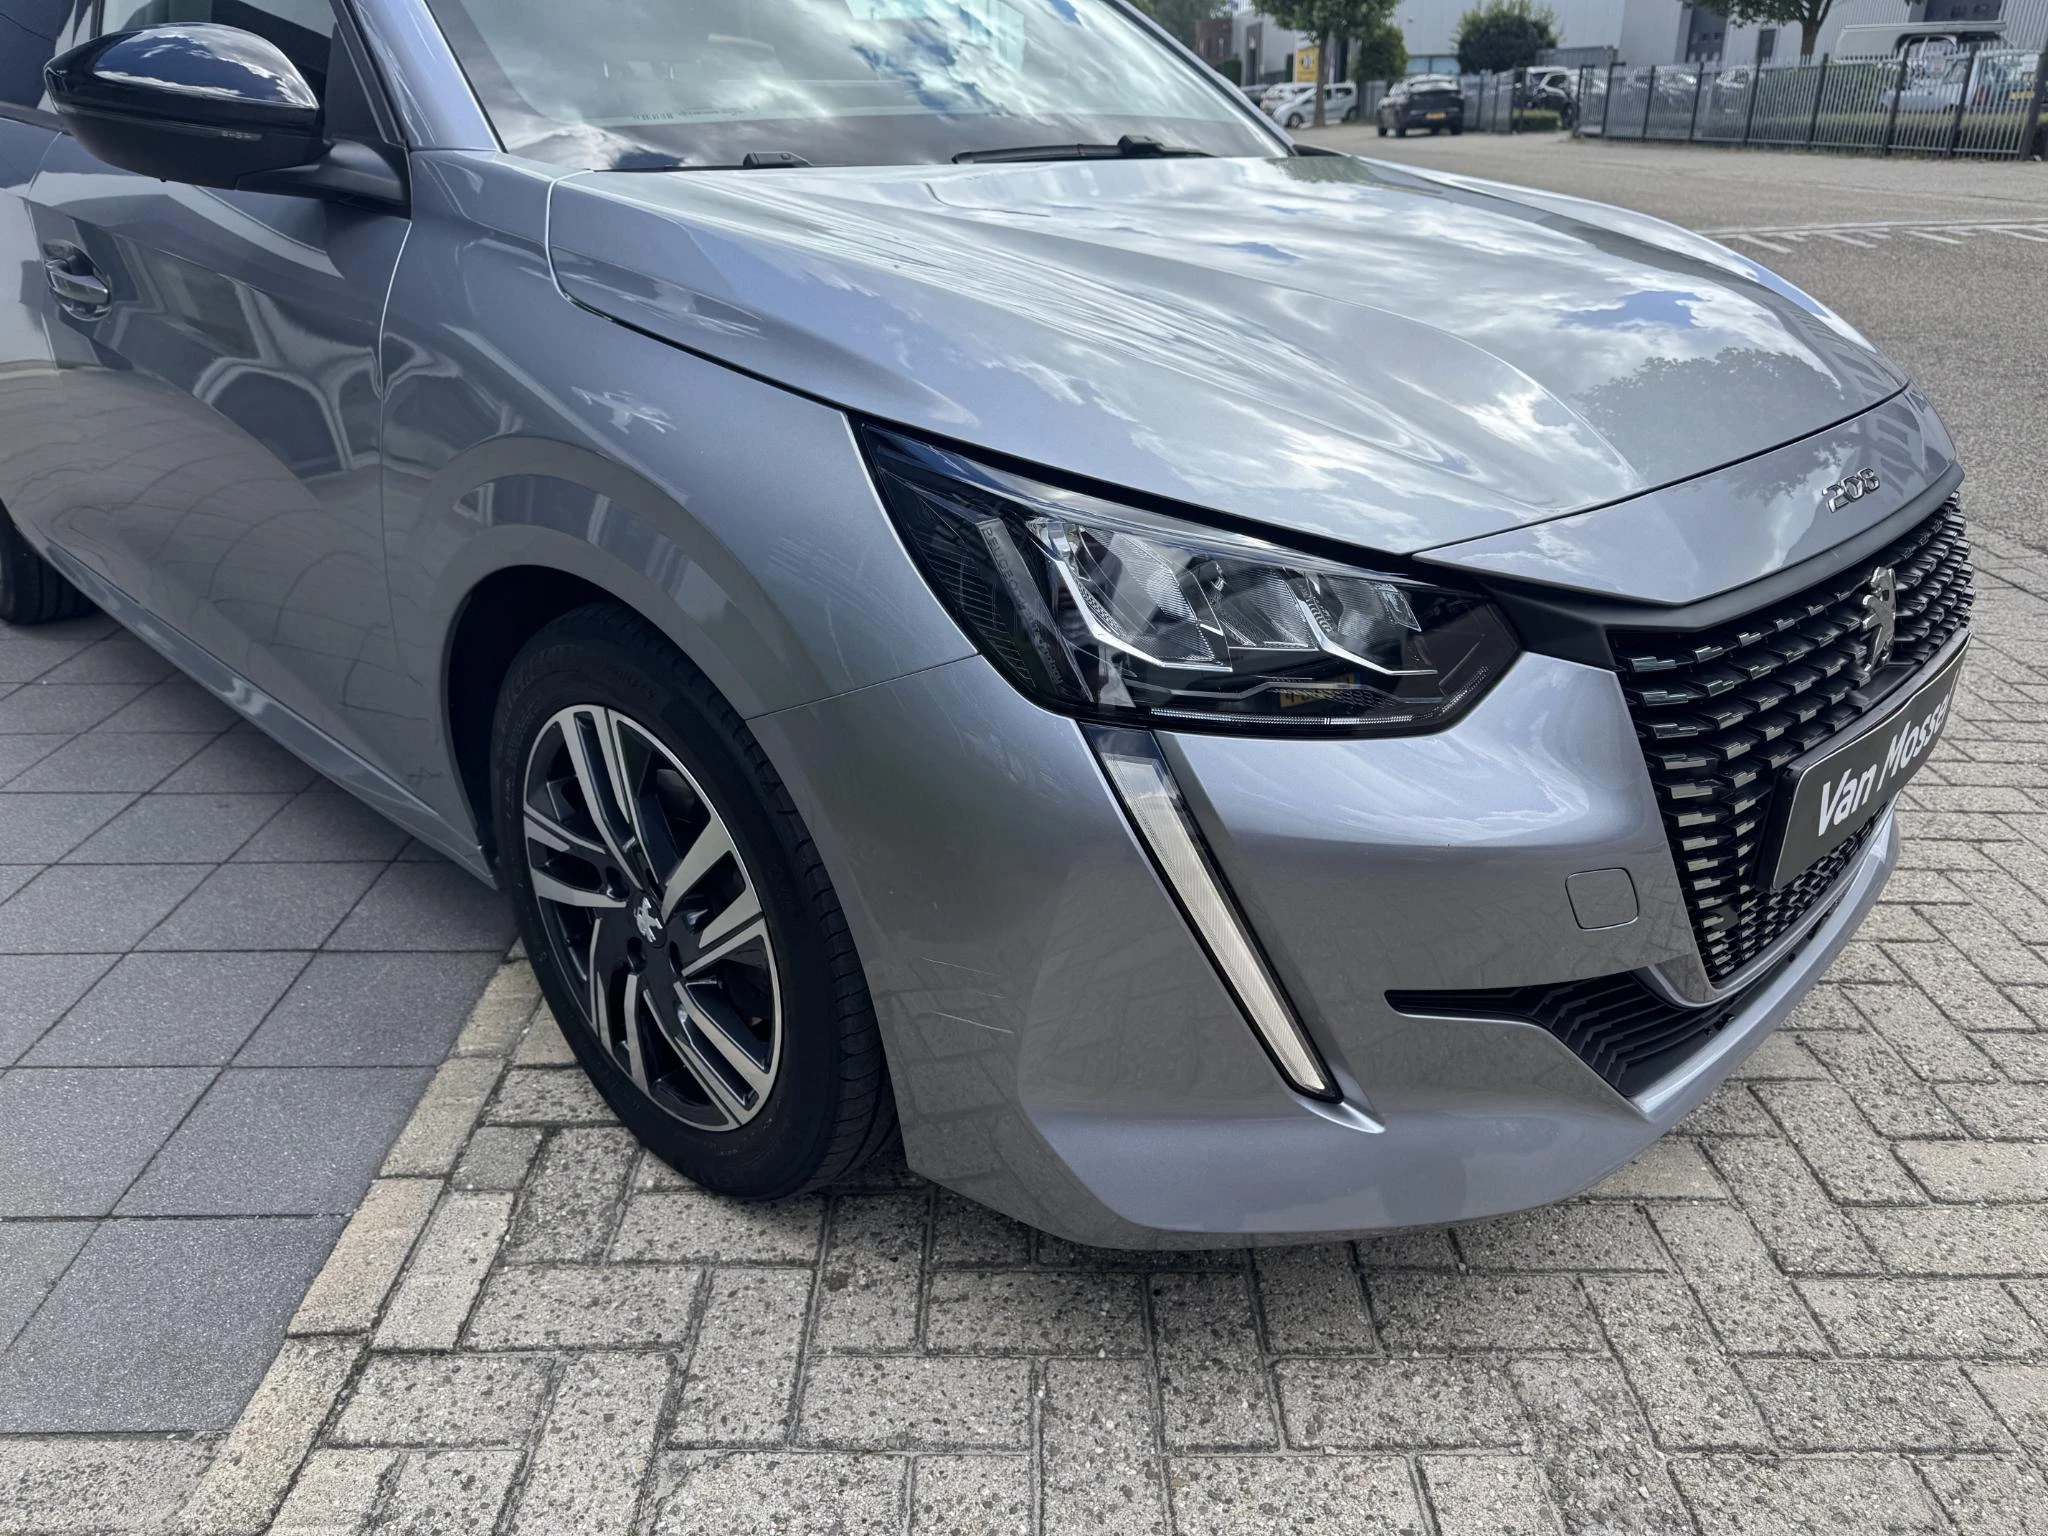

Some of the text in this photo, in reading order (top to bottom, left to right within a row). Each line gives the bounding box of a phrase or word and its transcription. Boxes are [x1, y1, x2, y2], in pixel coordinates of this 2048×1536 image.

[1821, 467, 1880, 514] 208
[981, 526, 1025, 599] PEUGEOT
[1818, 763, 1878, 837] Van
